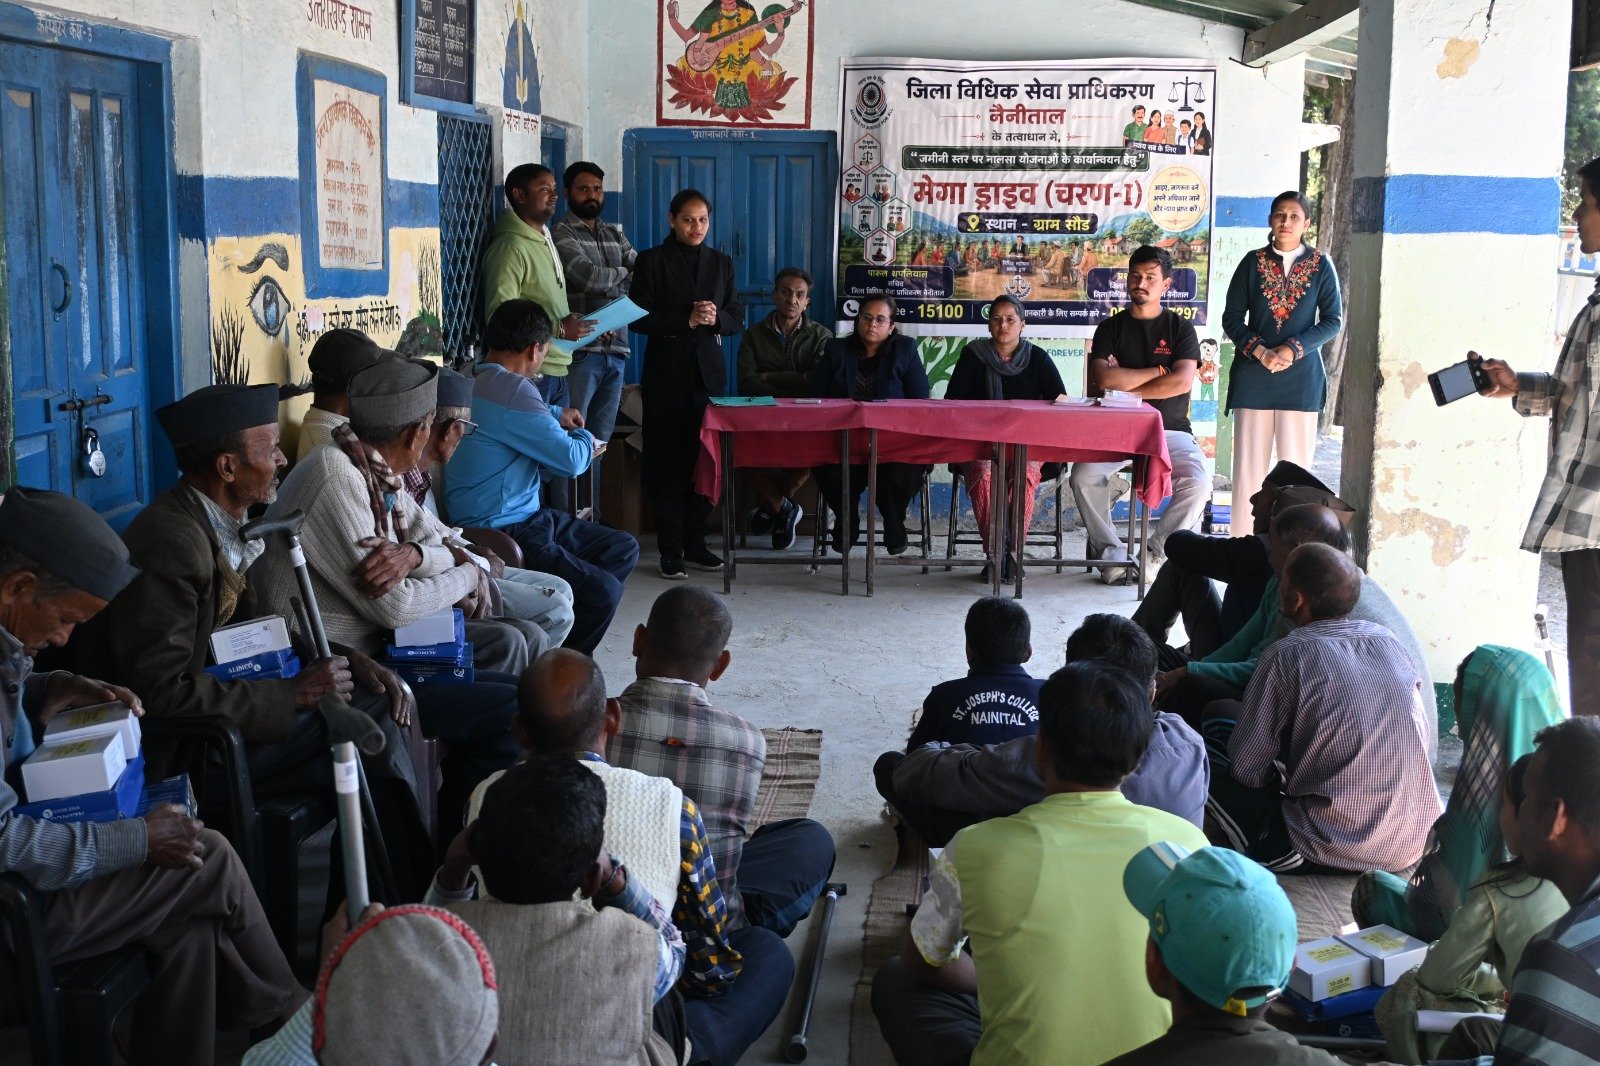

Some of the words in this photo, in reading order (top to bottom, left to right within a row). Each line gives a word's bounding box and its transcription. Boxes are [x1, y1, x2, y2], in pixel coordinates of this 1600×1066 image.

[349, 5, 372, 41] शासन
[906, 77, 952, 99] जिला
[957, 78, 1019, 99] विधिक
[1024, 78, 1062, 99] सेवा
[1068, 77, 1155, 99] प्राधिकरण
[989, 104, 1066, 124] नैनीताल
[991, 130, 1001, 141] के
[1157, 144, 1164, 152] के
[951, 155, 969, 164] स्तर
[972, 155, 984, 163] पर
[986, 155, 1016, 163] नालसा
[1019, 153, 1059, 165] योजनाओं
[1061, 153, 1070, 164] के
[1073, 153, 1121, 165] कार्यान्वयन
[913, 174, 967, 204] मेगा
[974, 182, 1039, 211] ड्राइव
[985, 218, 1017, 230] स्थान
[1033, 218, 1060, 231] ग्राम
[923, 288, 945, 296] नैनीताल
[918, 304, 963, 318] 15100
[1048, 308, 1054, 317] के
[1056, 308, 1067, 317] लिए
[1047, 349, 1084, 357] FOREVER
[952, 706, 968, 721] ST.
[965, 690, 1006, 711] JOSEPH'S
[970, 711, 1026, 726] NAINITAL
